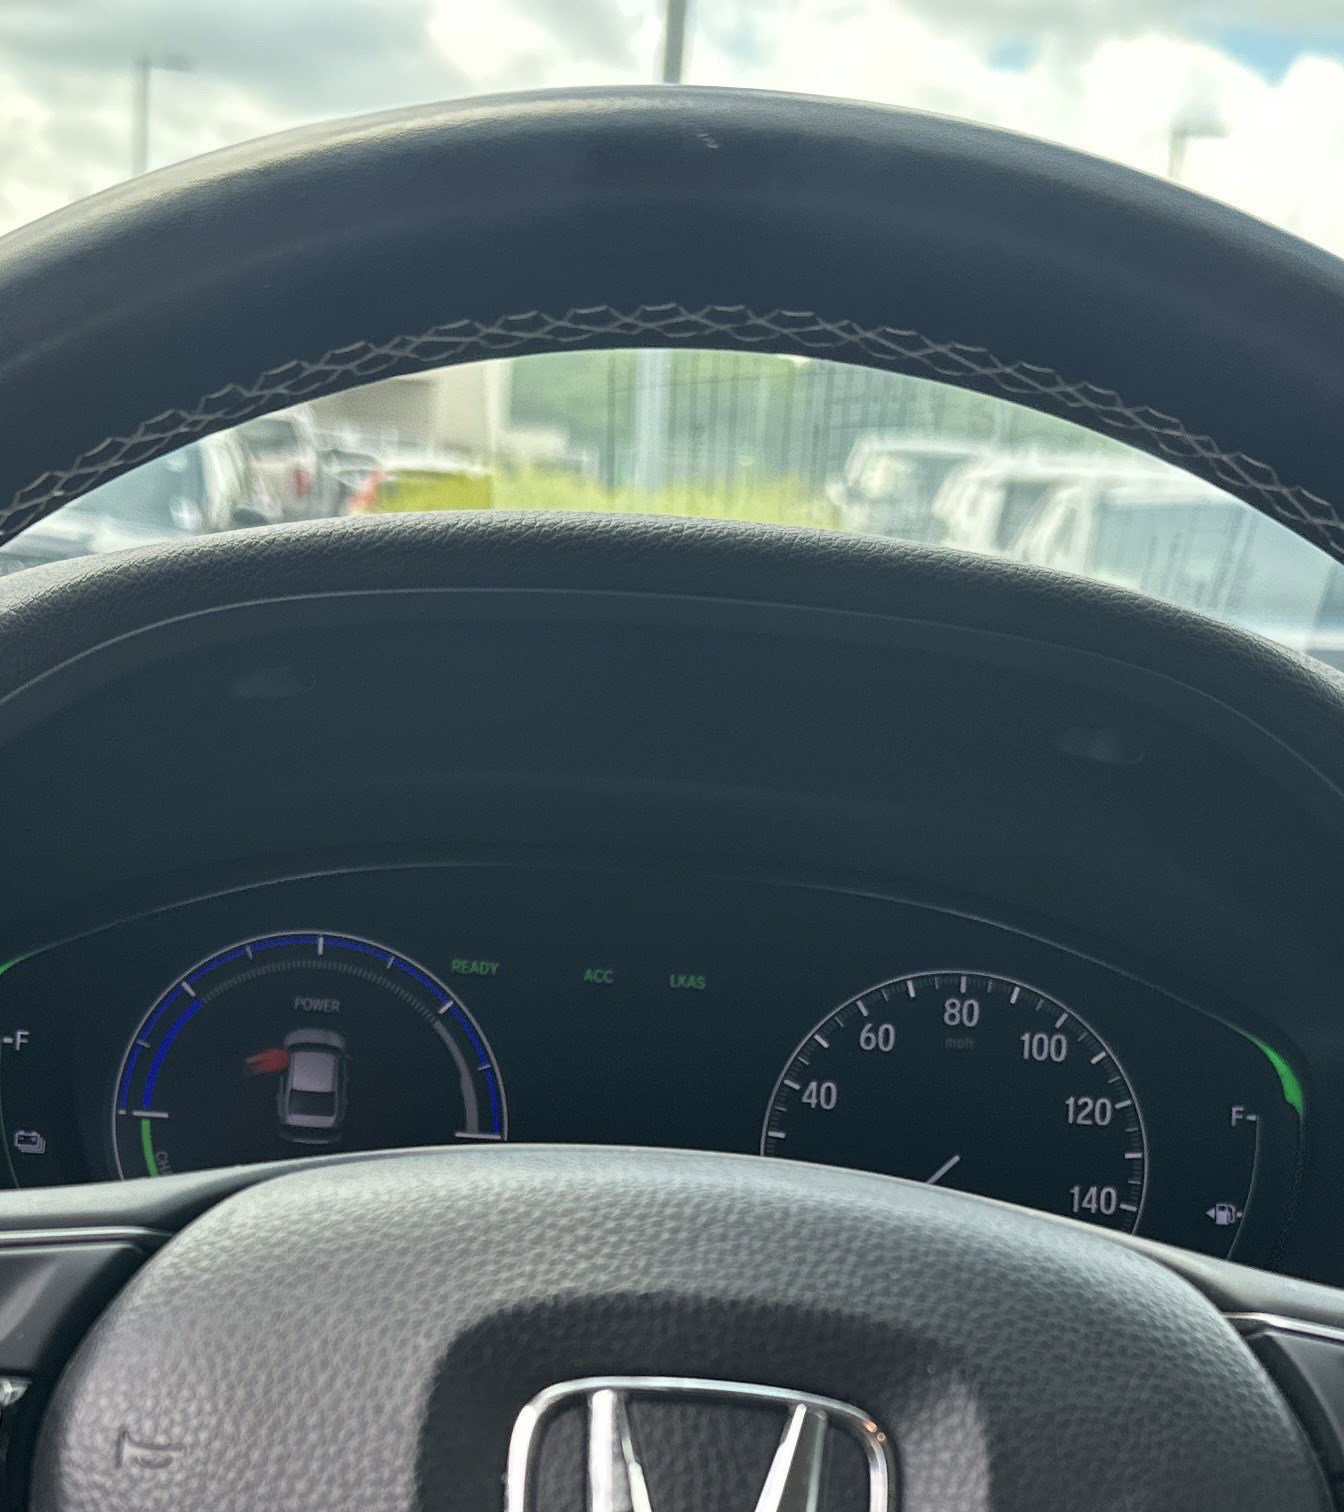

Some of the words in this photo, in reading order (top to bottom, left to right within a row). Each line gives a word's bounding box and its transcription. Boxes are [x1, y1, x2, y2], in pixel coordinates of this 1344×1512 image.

[452, 959, 498, 976] READY
[584, 969, 614, 983] ACC
[293, 998, 340, 1013] POWER
[943, 1000, 979, 1028] 80
[16, 1029, 30, 1051] F
[859, 1024, 895, 1052] 60
[1020, 1033, 1067, 1063] 100
[801, 1081, 838, 1110] 40
[1065, 1097, 1112, 1127] 120
[1230, 1106, 1245, 1127] F
[1069, 1186, 1117, 1215] 140
